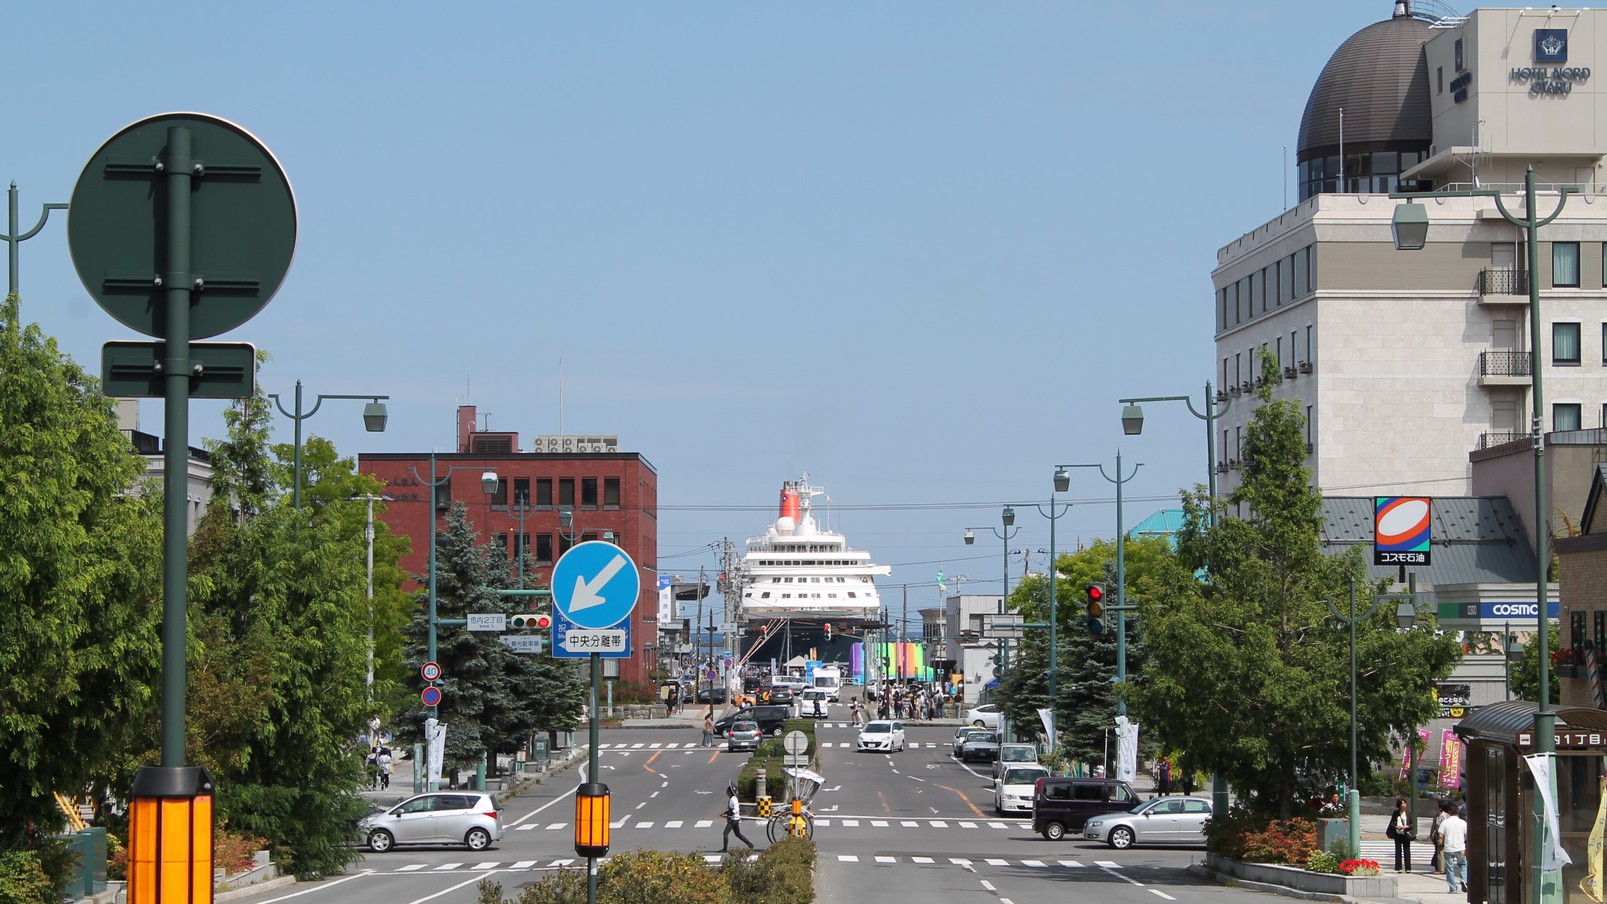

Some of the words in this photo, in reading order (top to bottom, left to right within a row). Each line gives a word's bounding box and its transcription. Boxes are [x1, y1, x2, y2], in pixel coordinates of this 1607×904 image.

[1511, 67, 1550, 79] HOTEL
[1553, 67, 1591, 79] NORD
[1531, 81, 1572, 94] OTARU
[1381, 553, 1425, 563] コスモ石油
[470, 616, 503, 624] 色内2丁目
[569, 634, 621, 648] 中央分離帯
[426, 667, 437, 676] 40
